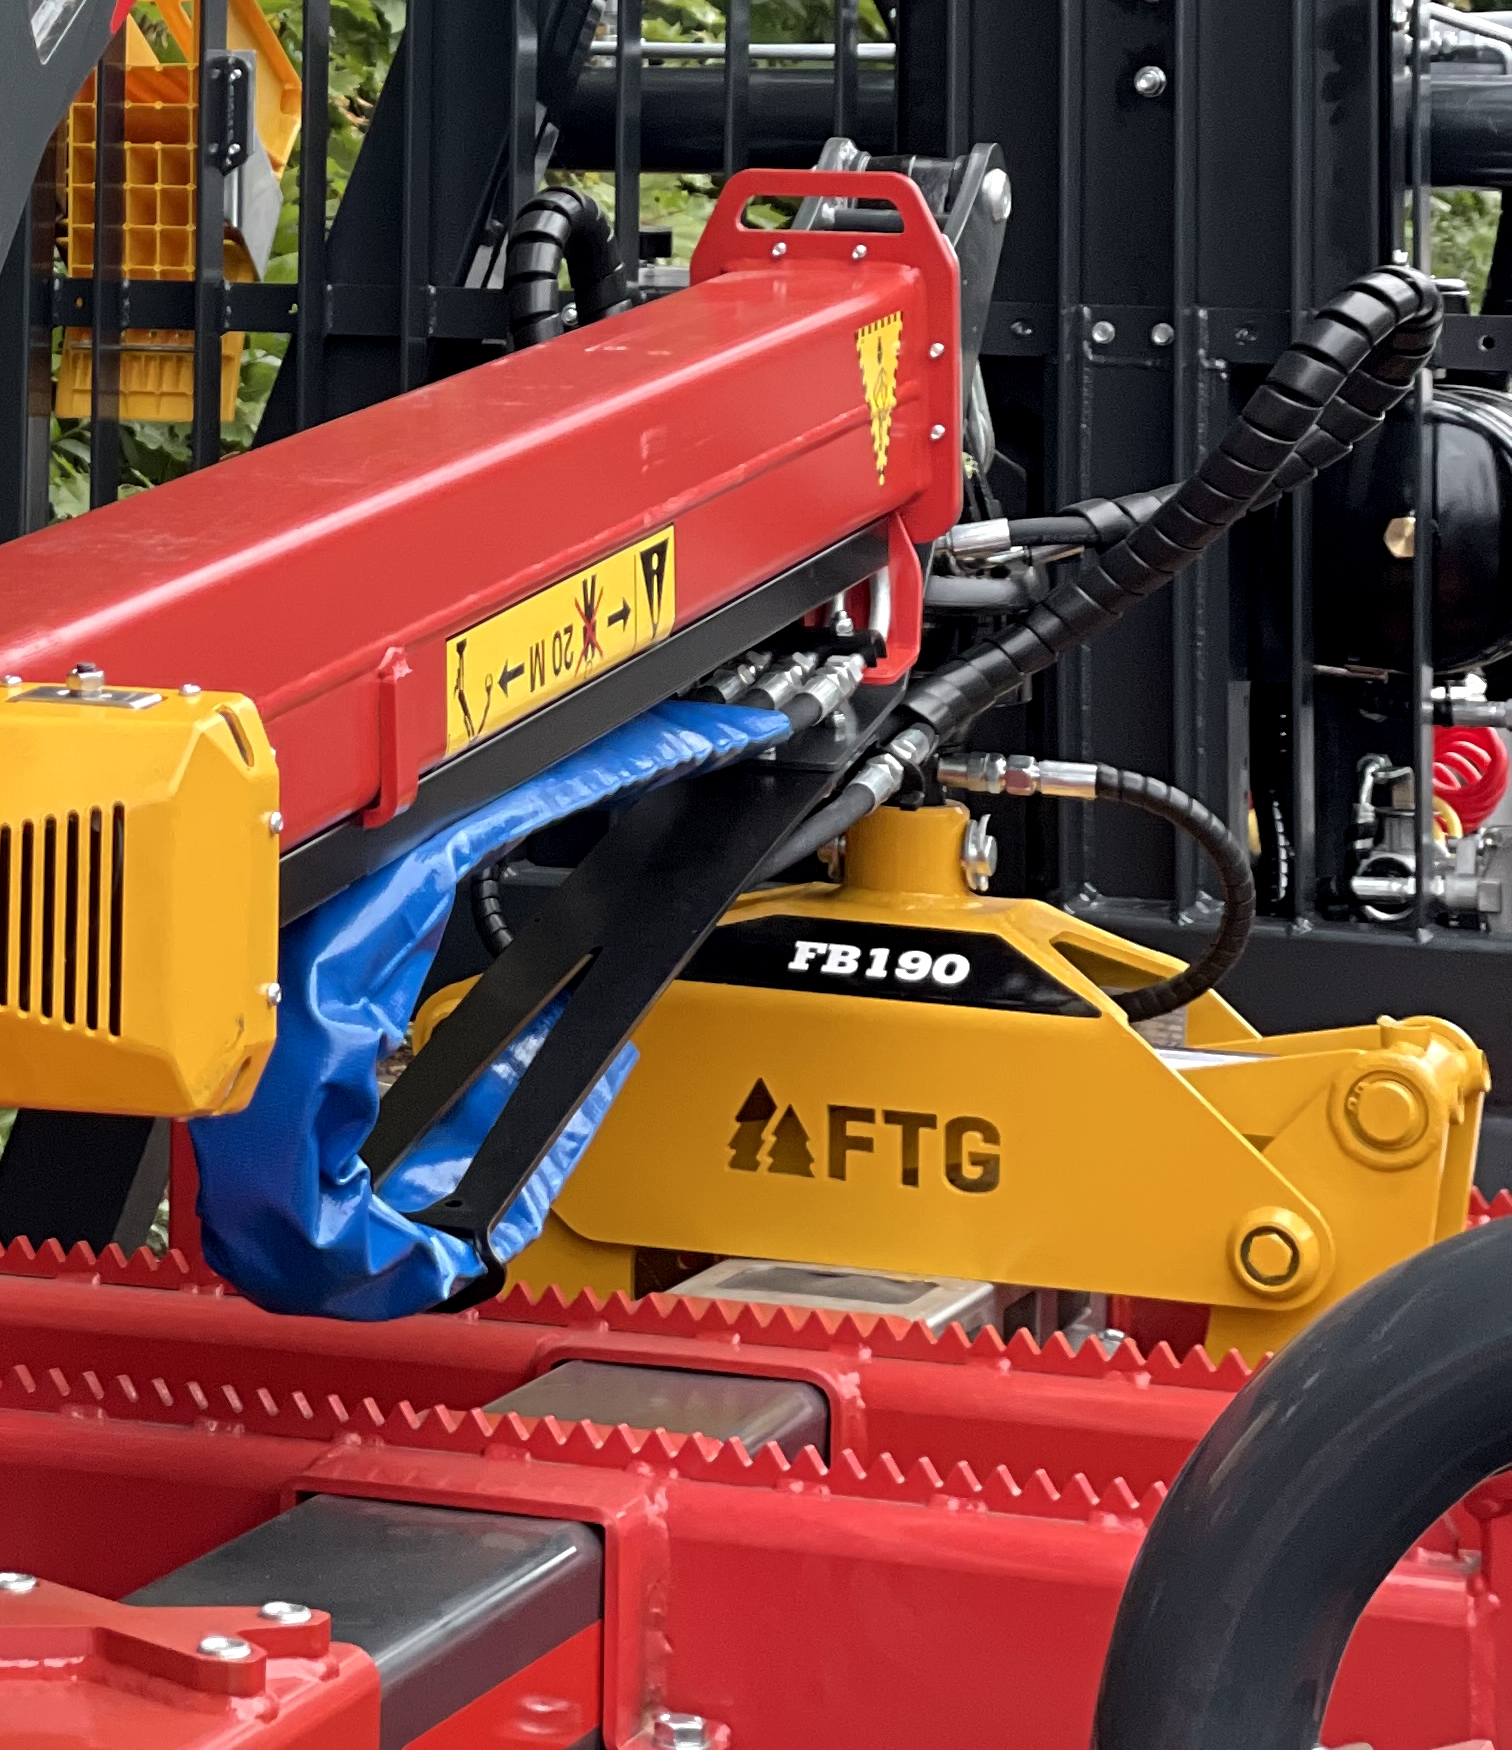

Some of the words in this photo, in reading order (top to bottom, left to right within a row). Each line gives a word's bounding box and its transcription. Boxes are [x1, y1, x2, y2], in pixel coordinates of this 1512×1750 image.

[529, 638, 546, 693] M
[552, 623, 575, 678] 20
[788, 940, 971, 985] FB190
[827, 1104, 1002, 1195] FTG
